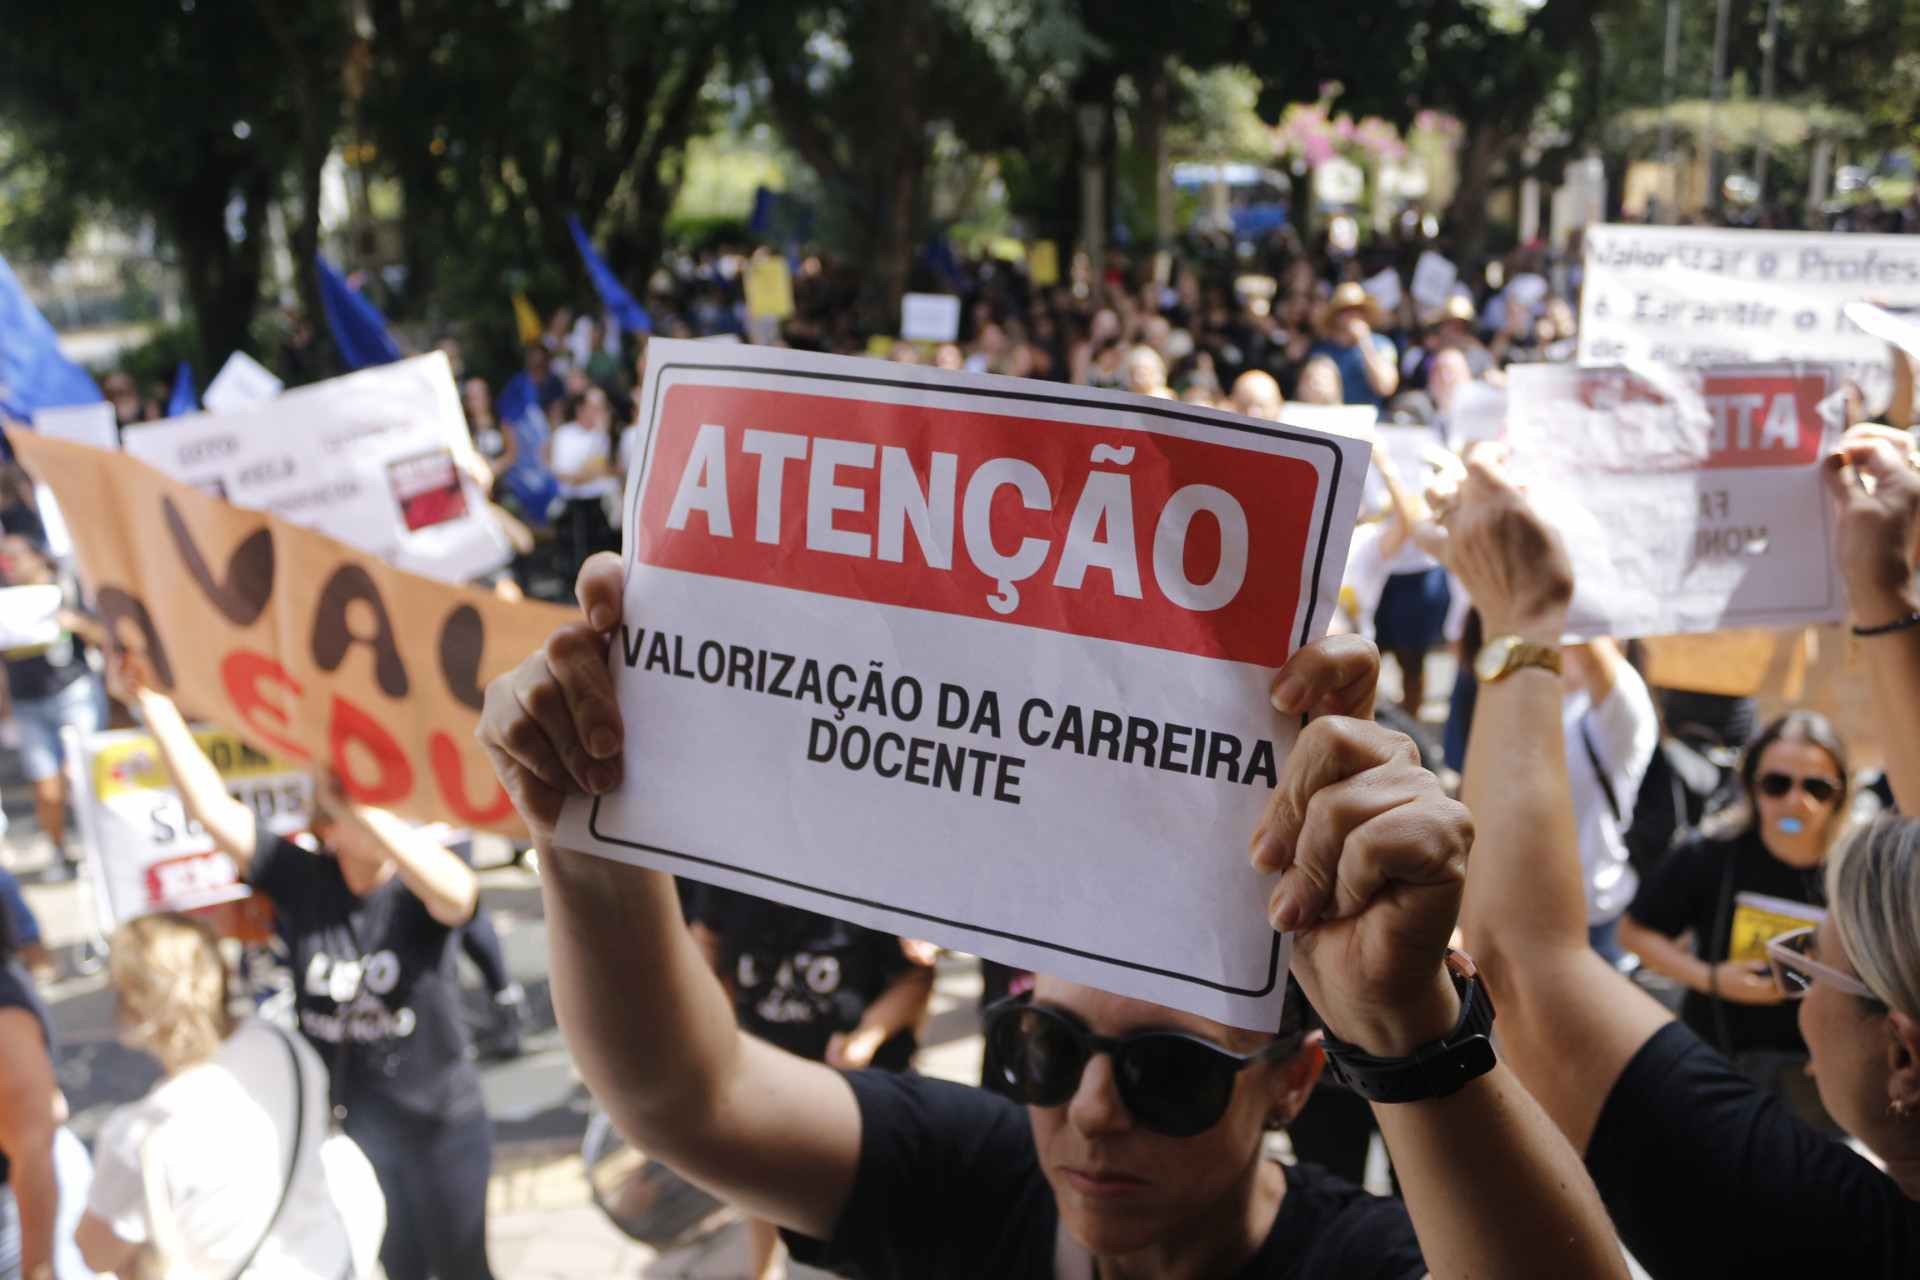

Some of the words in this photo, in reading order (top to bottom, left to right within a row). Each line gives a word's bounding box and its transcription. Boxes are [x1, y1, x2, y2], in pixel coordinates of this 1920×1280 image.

[665, 424, 1248, 614] ATENÇÃO
[620, 625, 922, 721] VALORIZAÇÃO
[936, 682, 1002, 739] DA
[1018, 697, 1279, 789] CARREIRA
[806, 717, 1027, 805] DOCENTE
